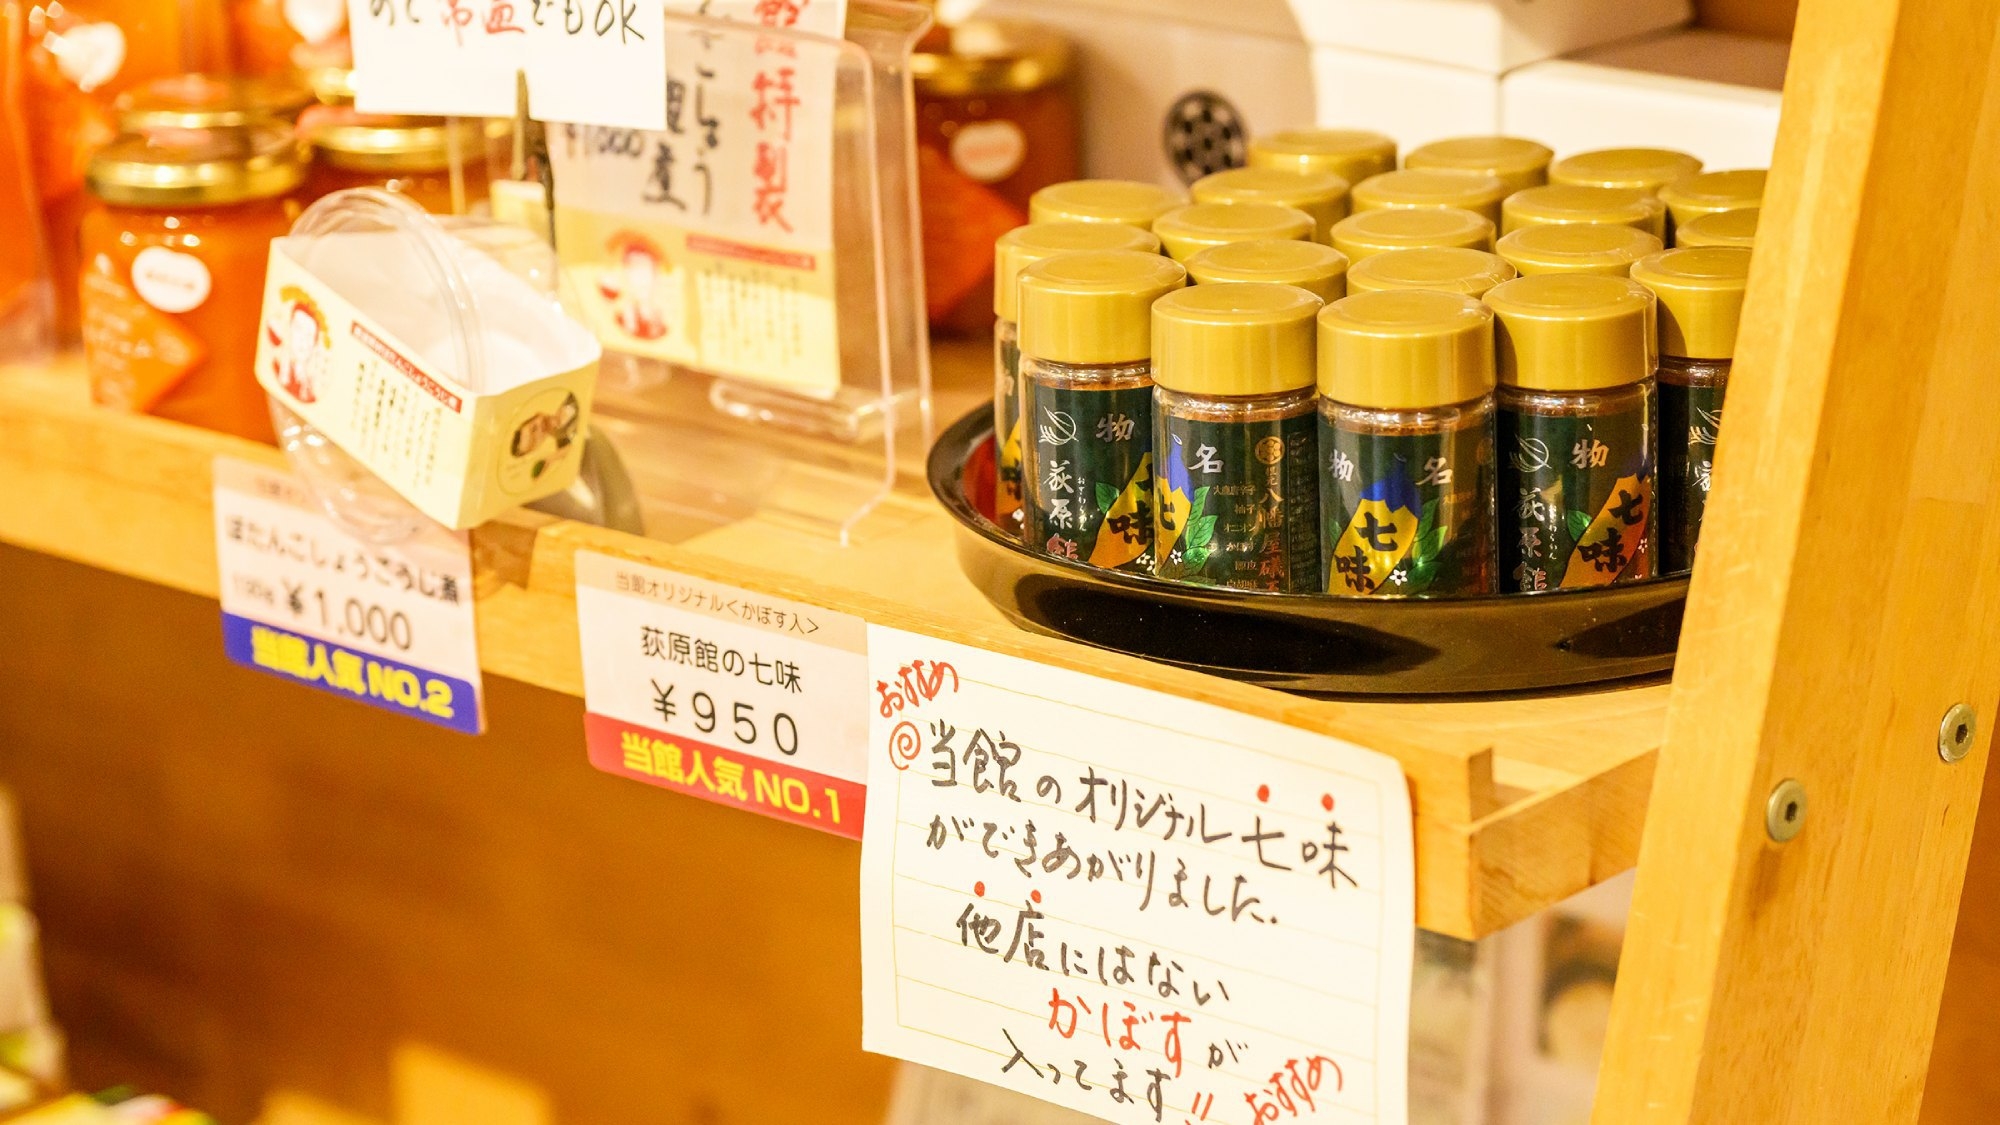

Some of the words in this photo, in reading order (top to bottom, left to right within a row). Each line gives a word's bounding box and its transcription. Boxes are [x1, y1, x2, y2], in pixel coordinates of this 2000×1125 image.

[1096, 413, 1135, 443] 物
[1569, 439, 1609, 468] 物
[1188, 443, 1224, 474] 名
[1328, 448, 1354, 482] 物
[1416, 456, 1453, 486] 名
[1334, 511, 1398, 593] 七味
[1577, 489, 1644, 573] 七味
[640, 625, 803, 693] 荻原館の七味
[621, 731, 748, 801] 当館人気
[752, 769, 841, 823] NO.1
[956, 901, 1230, 1004] 他店にはない
